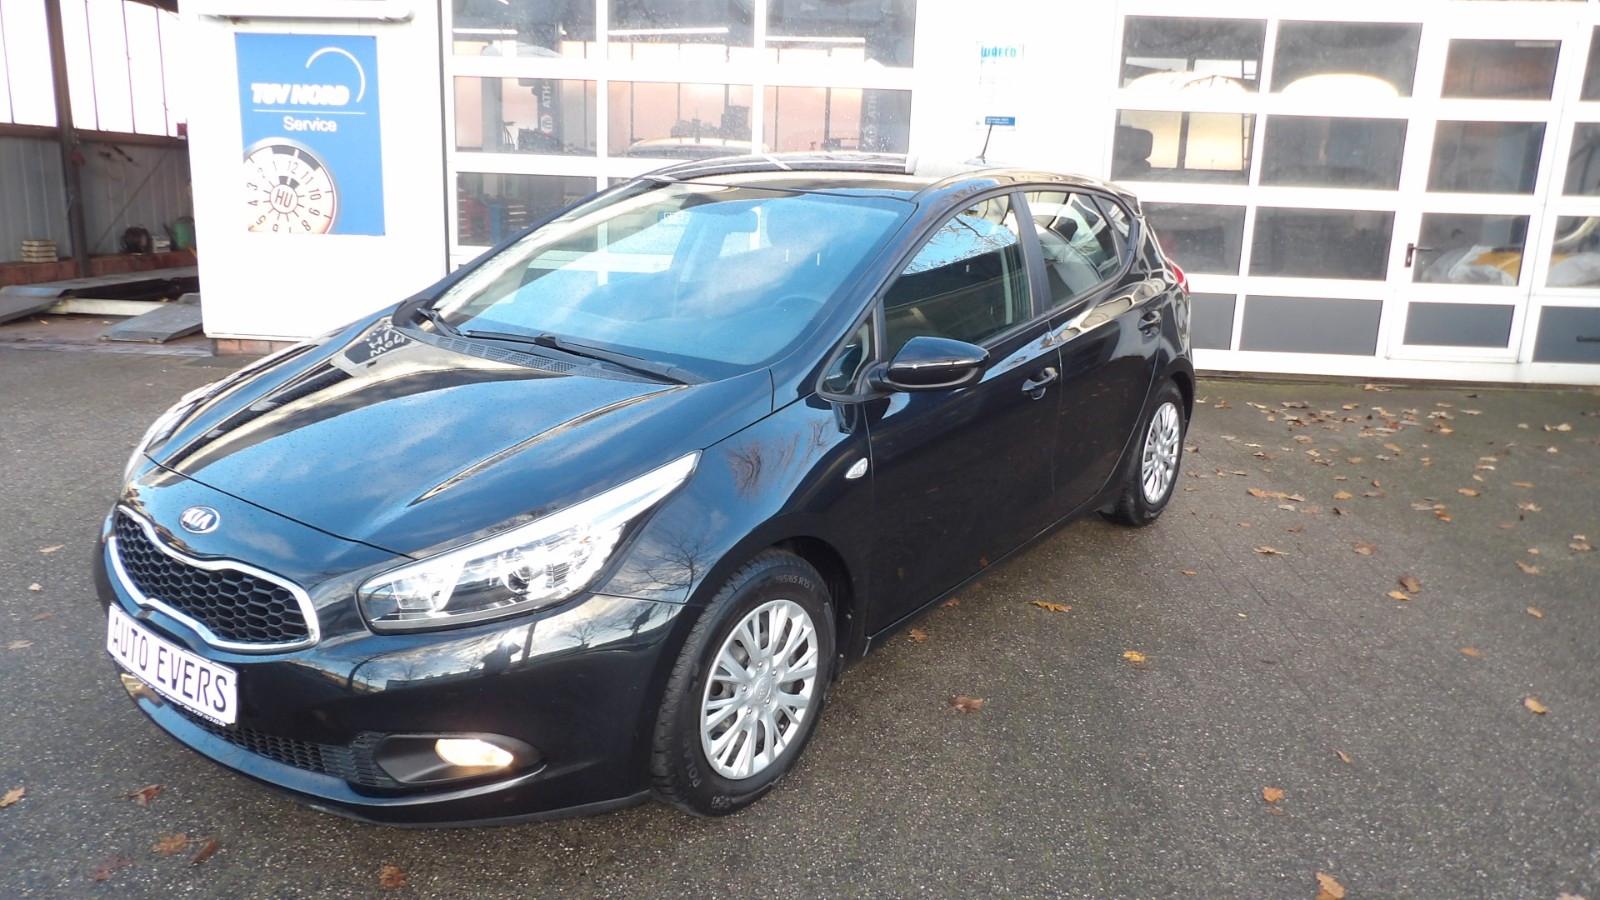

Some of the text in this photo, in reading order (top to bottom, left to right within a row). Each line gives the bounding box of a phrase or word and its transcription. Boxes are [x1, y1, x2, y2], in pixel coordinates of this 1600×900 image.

[290, 83, 350, 105] NORD
[283, 115, 337, 132] Service
[287, 160, 299, 175] 12
[300, 171, 315, 185] 11
[275, 189, 293, 208] HU
[308, 188, 322, 201] 10
[301, 219, 312, 232] 8
[113, 616, 228, 713] AUTO EVERS
